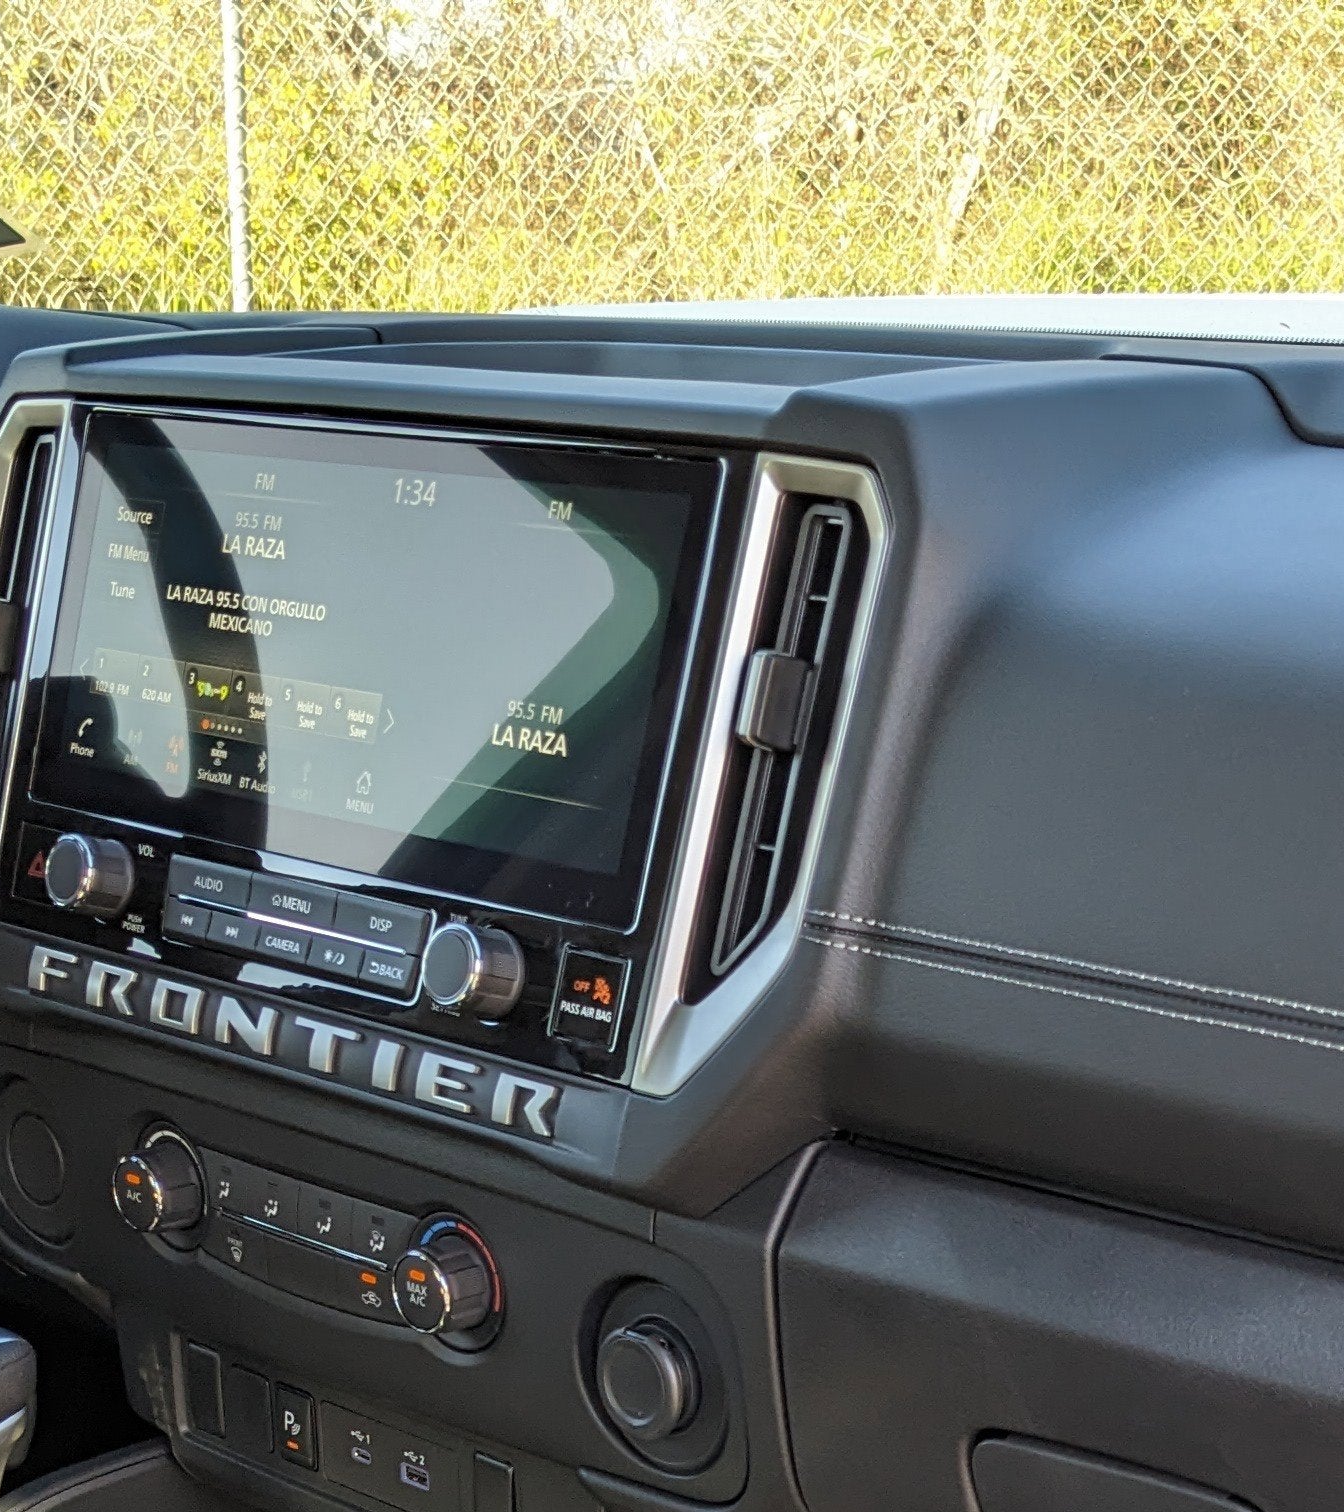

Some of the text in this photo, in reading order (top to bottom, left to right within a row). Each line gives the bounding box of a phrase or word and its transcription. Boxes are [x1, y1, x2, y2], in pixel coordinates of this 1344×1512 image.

[255, 473, 275, 491] FM
[394, 478, 437, 507] 1:34
[117, 506, 153, 525] Source
[548, 501, 573, 520] FM
[236, 511, 282, 531] 95.5 FM
[108, 543, 149, 562] FM Menu
[222, 534, 286, 560] LA RAZA
[110, 581, 135, 599] Tune
[166, 584, 326, 621] LA RAZA 95.5 CON ORGULLO
[208, 612, 273, 636] MEXICANO
[143, 665, 150, 677] 2
[188, 672, 196, 685] 3
[235, 680, 243, 692] 4
[141, 688, 172, 703] 620 AM
[247, 692, 273, 707] Hold to
[284, 688, 292, 701] 5
[297, 700, 323, 715] Hold to
[334, 696, 341, 710] 6
[249, 707, 267, 721] Save
[347, 709, 374, 725] Hold to
[507, 701, 563, 725] 95.5 FM
[298, 716, 316, 730] Save
[349, 725, 367, 739] Save
[492, 723, 567, 757] LA RAZA
[70, 742, 95, 758] Phone
[239, 776, 250, 789] BT
[345, 799, 374, 814] MENU
[138, 844, 155, 858] VOL
[193, 876, 223, 892] AUDIO
[282, 896, 312, 914] MENU
[122, 921, 146, 933] POWER
[369, 916, 392, 933] DISP
[265, 936, 300, 954] CAMERA
[378, 964, 404, 980] BACK
[560, 1000, 612, 1023] PASS AIR BAG
[27, 944, 556, 1137] FRONTIER
[126, 1189, 142, 1203] A/C
[406, 1281, 427, 1297] MAX
[409, 1293, 426, 1307] A/C
[284, 1410, 295, 1431] P
[366, 1435, 370, 1445] 1
[419, 1455, 425, 1466] 2
